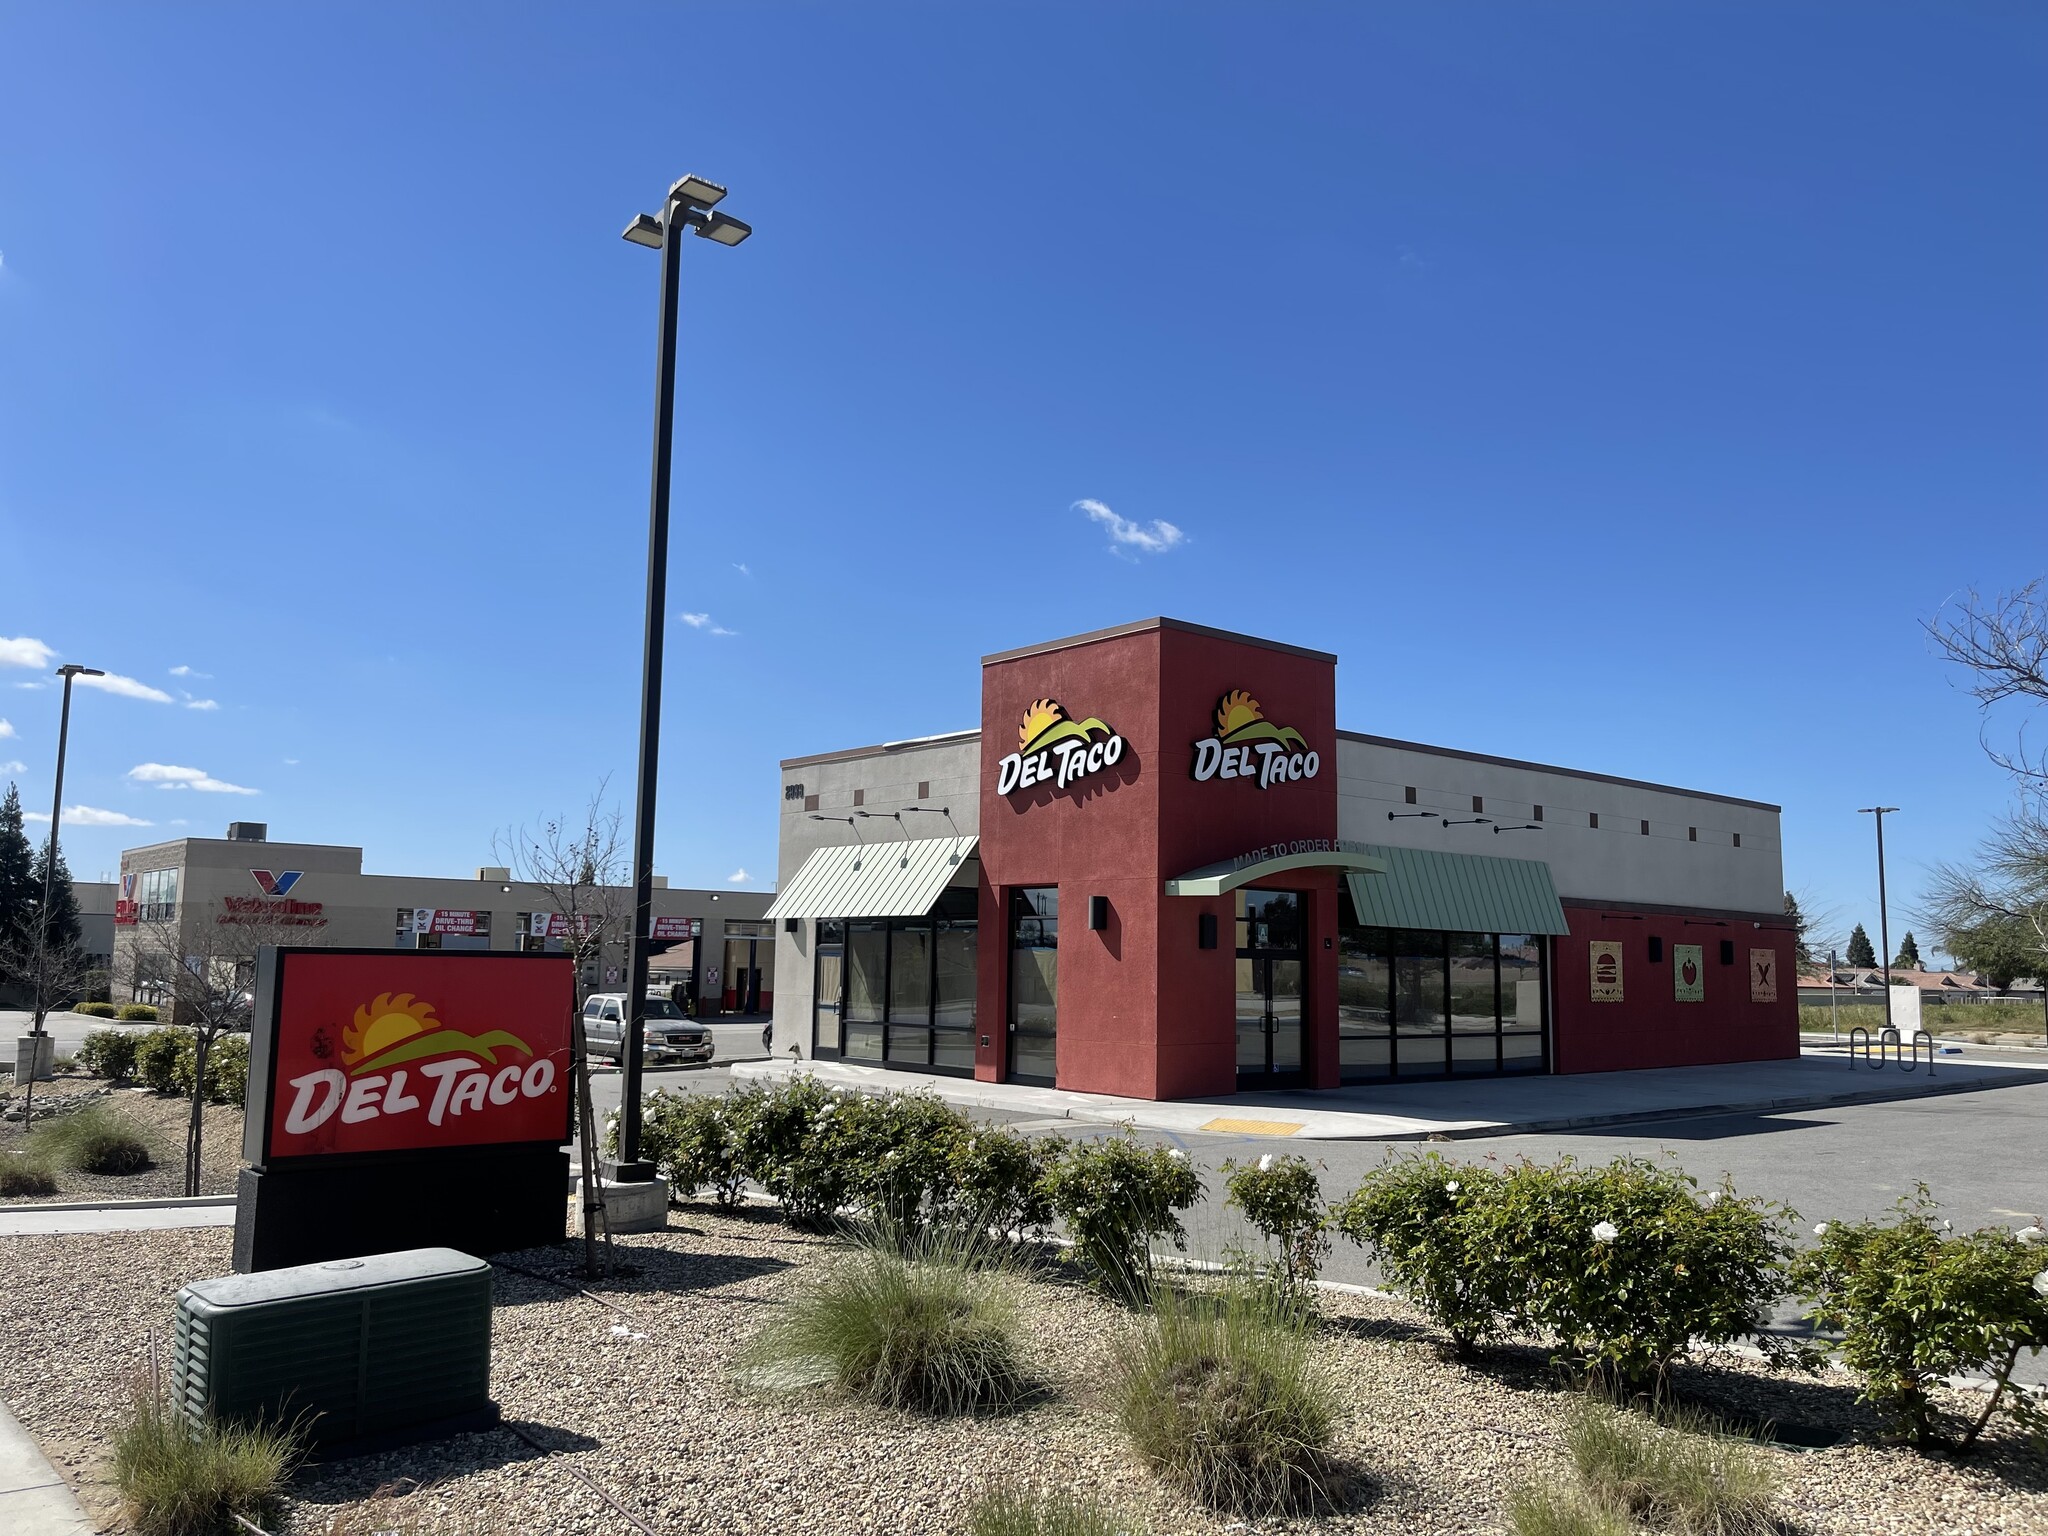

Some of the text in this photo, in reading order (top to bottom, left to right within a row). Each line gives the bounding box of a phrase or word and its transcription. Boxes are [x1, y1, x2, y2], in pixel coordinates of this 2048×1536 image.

[997, 735, 1122, 796] DEL TACO
[1194, 738, 1320, 790] DEL TACO
[1233, 847, 1269, 871] MADE
[1270, 843, 1288, 858] TO
[1290, 839, 1331, 853] ORDER
[435, 917, 474, 925] DRIVE-THRU
[285, 1057, 555, 1135] DEL TACO
